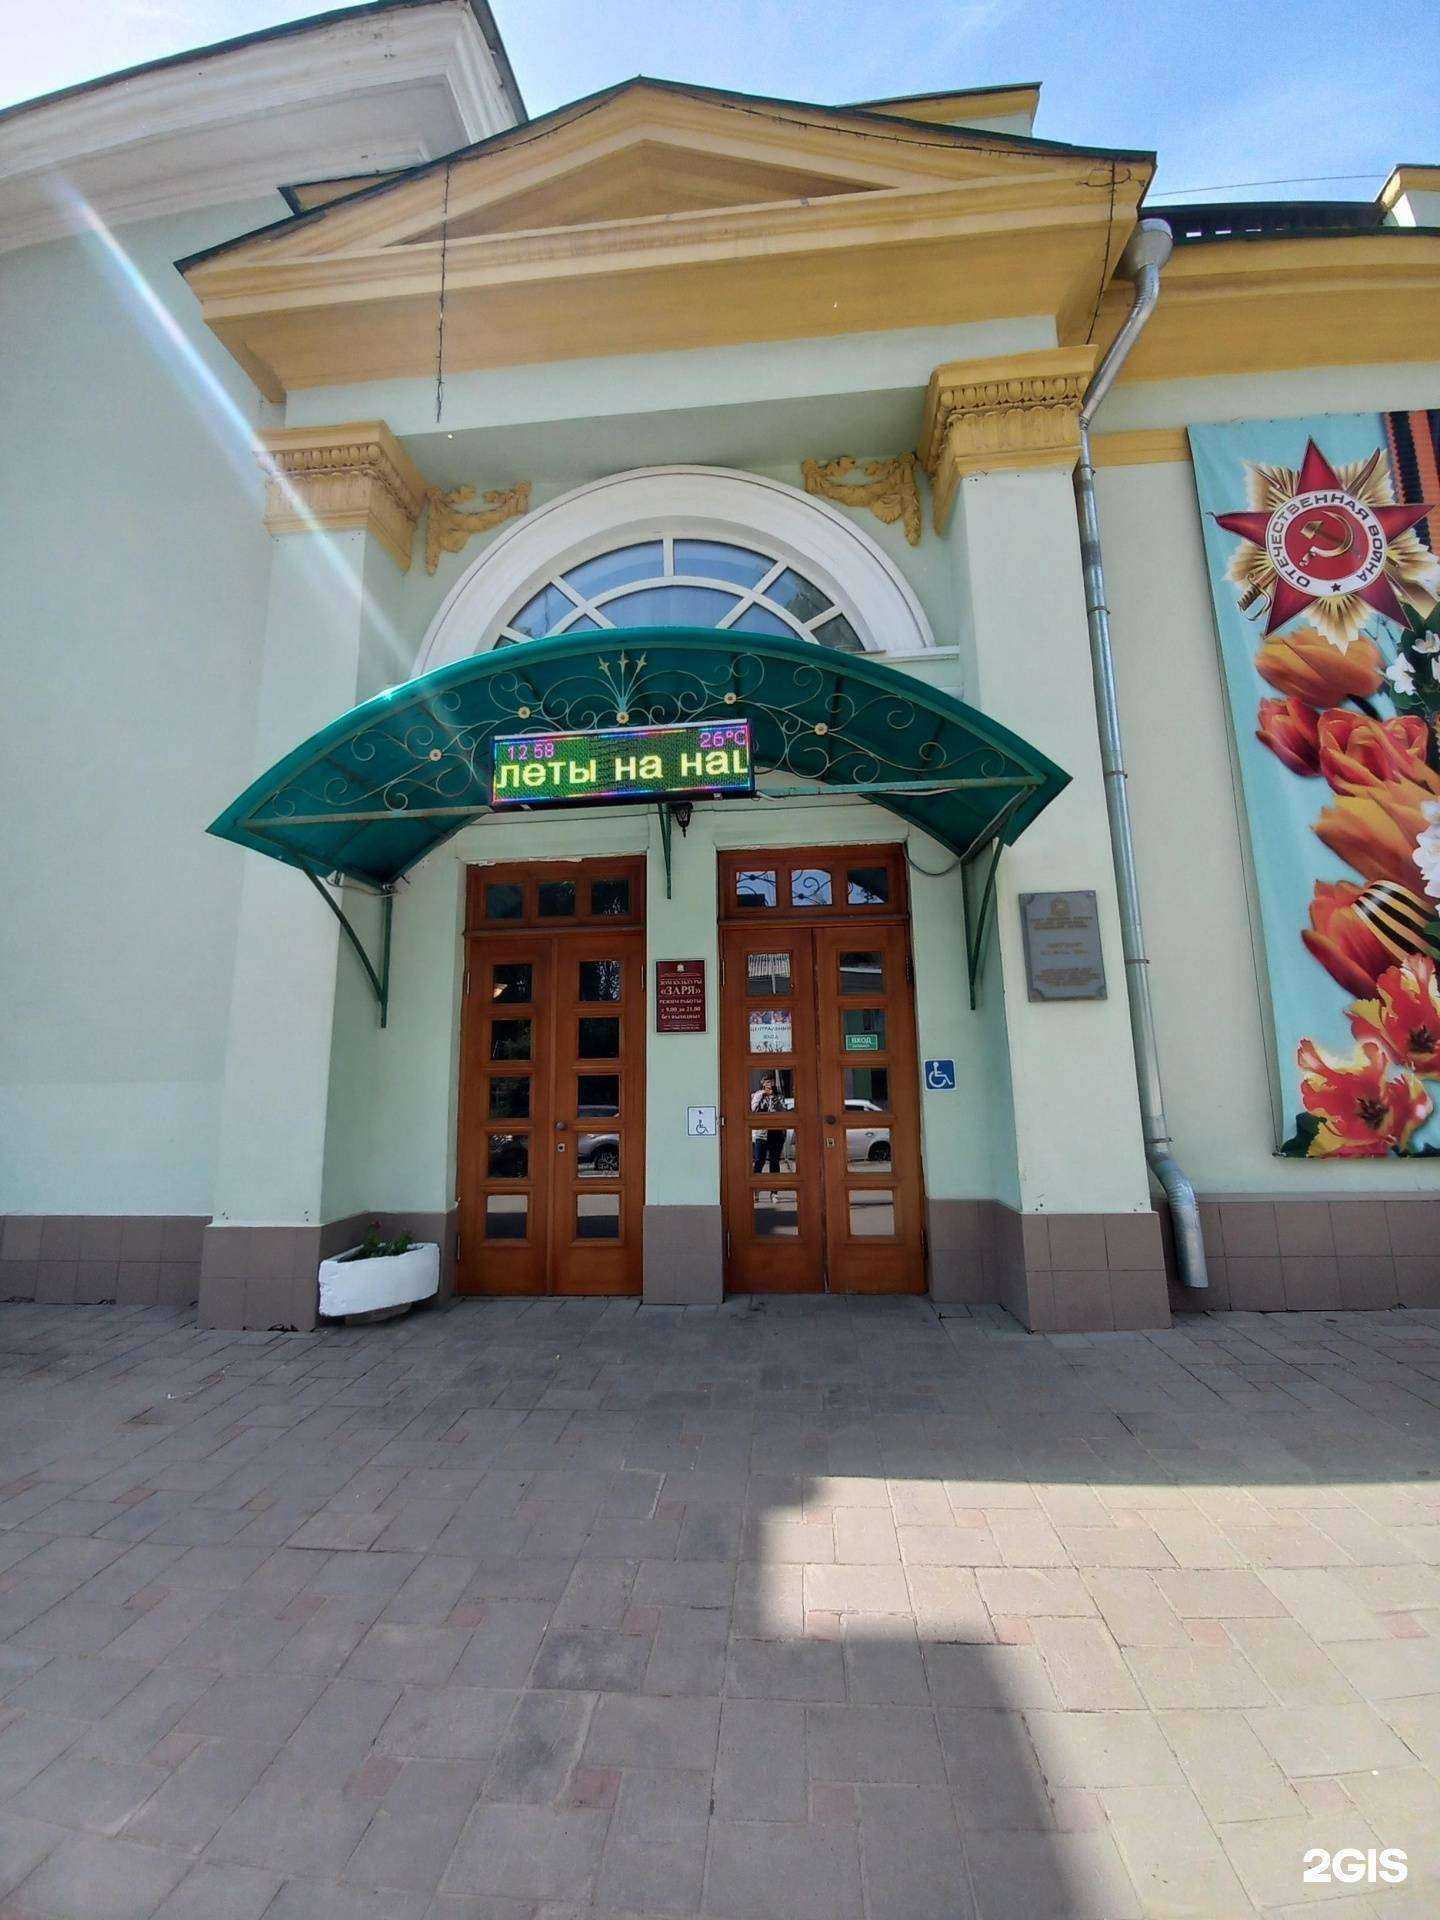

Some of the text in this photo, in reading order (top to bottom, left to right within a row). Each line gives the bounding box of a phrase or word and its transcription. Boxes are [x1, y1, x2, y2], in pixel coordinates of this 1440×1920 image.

[1271, 493, 1370, 588] ОТЕЧЕСТВЕННАЯ
[497, 760, 597, 788] леты
[615, 755, 663, 781] на
